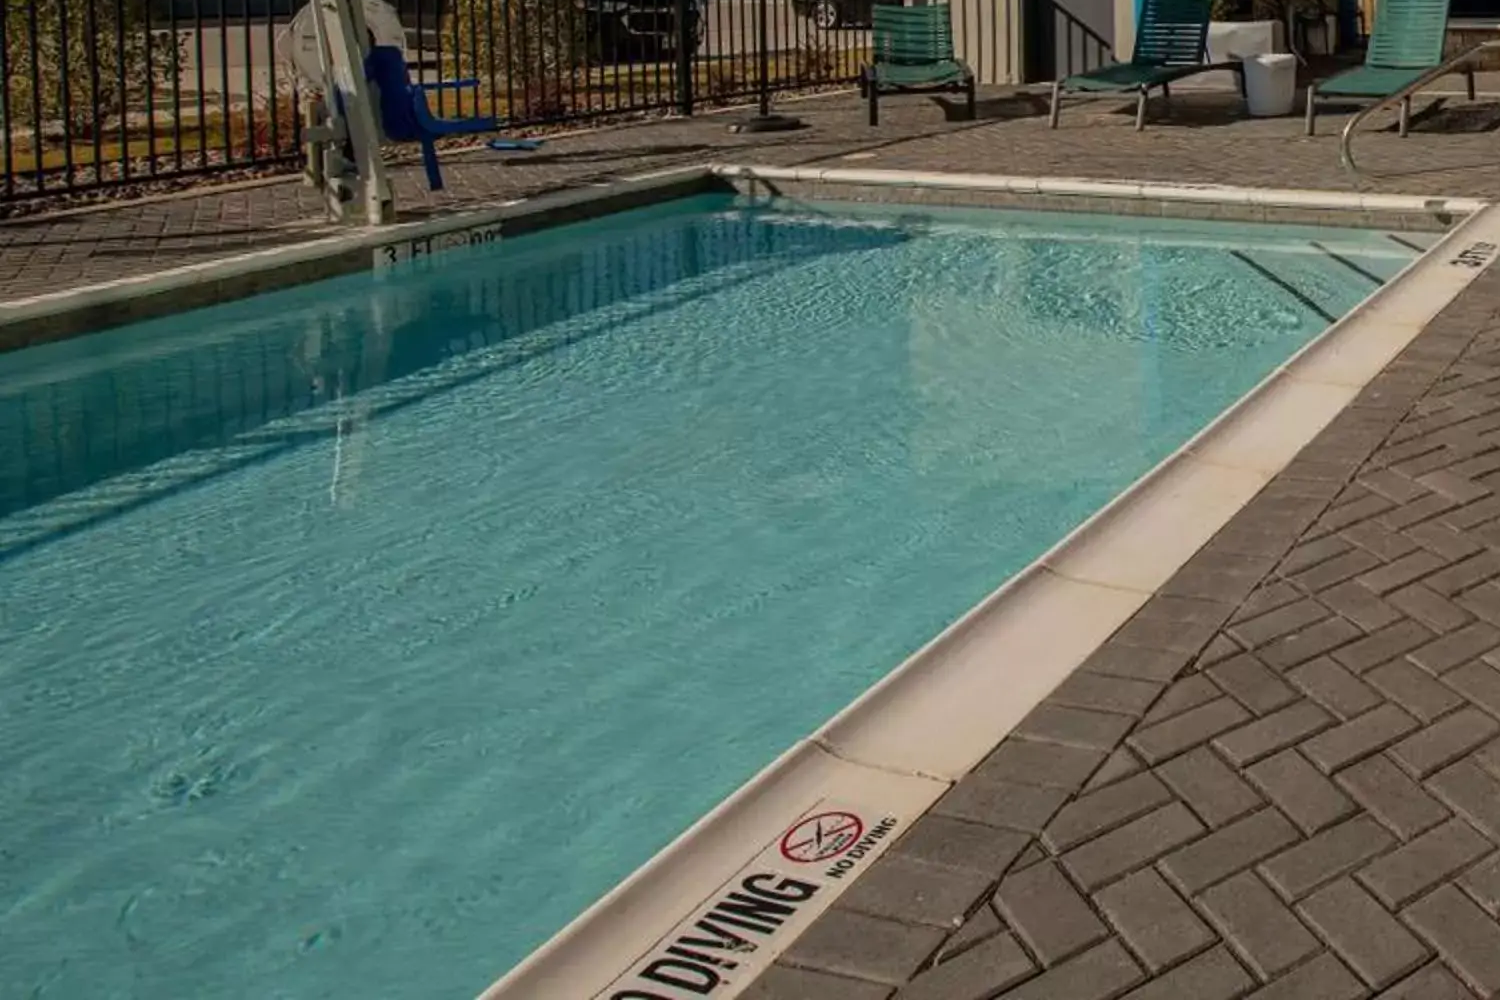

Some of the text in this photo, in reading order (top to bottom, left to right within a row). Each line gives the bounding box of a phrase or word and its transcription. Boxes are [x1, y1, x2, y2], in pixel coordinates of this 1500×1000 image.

[825, 859, 855, 879] NO
[849, 817, 898, 859] DIVING
[638, 873, 821, 995] DIVING
